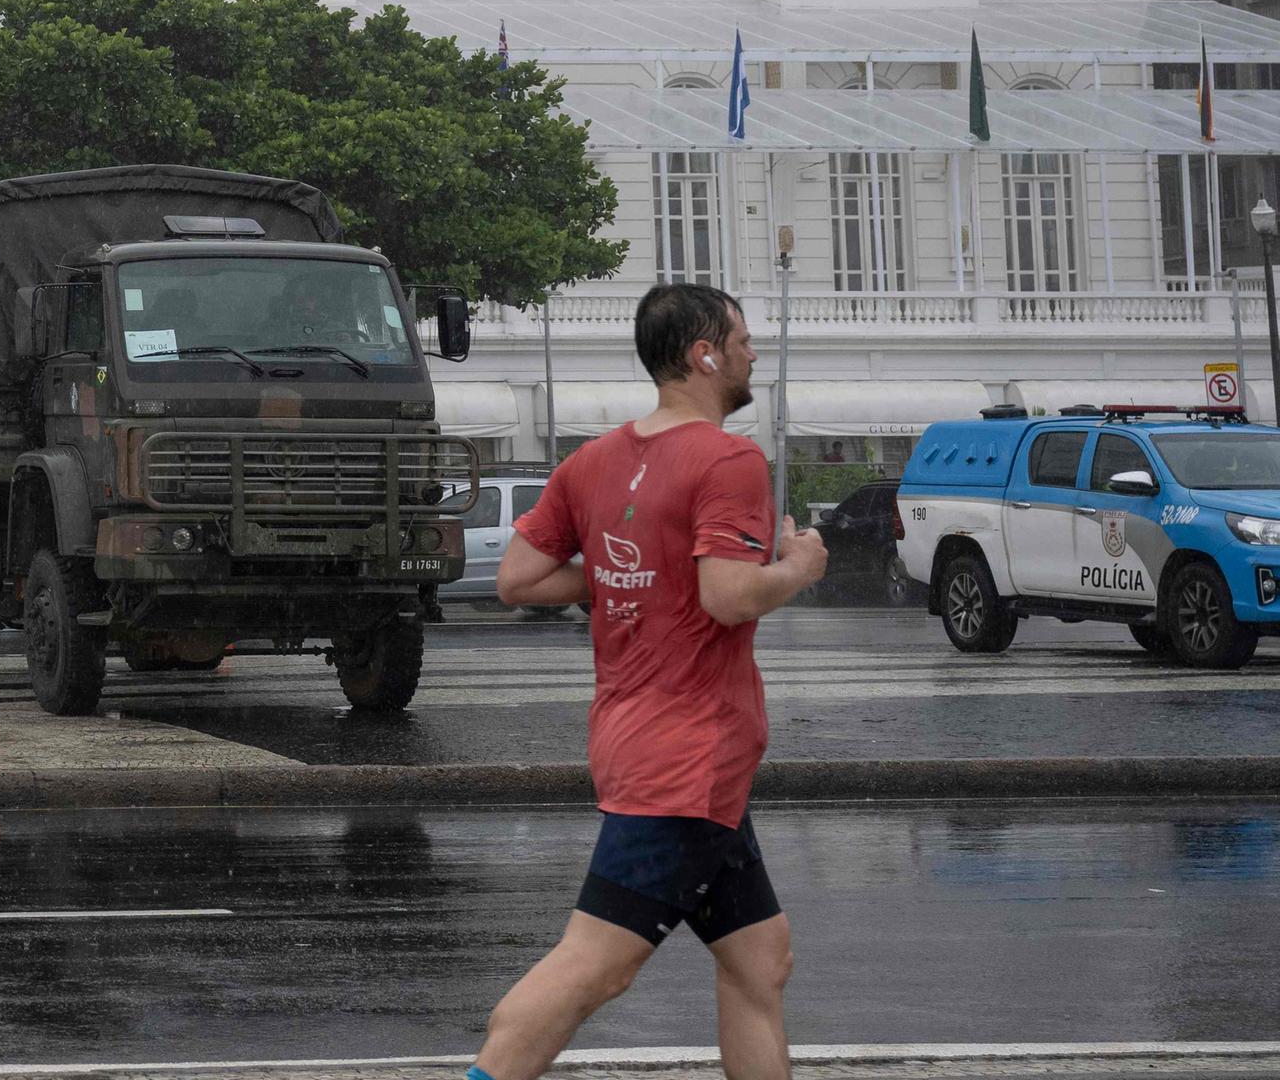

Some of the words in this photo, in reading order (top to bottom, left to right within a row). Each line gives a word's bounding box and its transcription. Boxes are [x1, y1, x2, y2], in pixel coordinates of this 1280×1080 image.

[869, 424, 914, 433] GUCCI
[911, 507, 927, 521] 190
[400, 560, 413, 570] EB
[416, 560, 441, 570] 17631
[594, 565, 657, 589] PACEFIT
[1081, 563, 1145, 591] POLÍCIA
